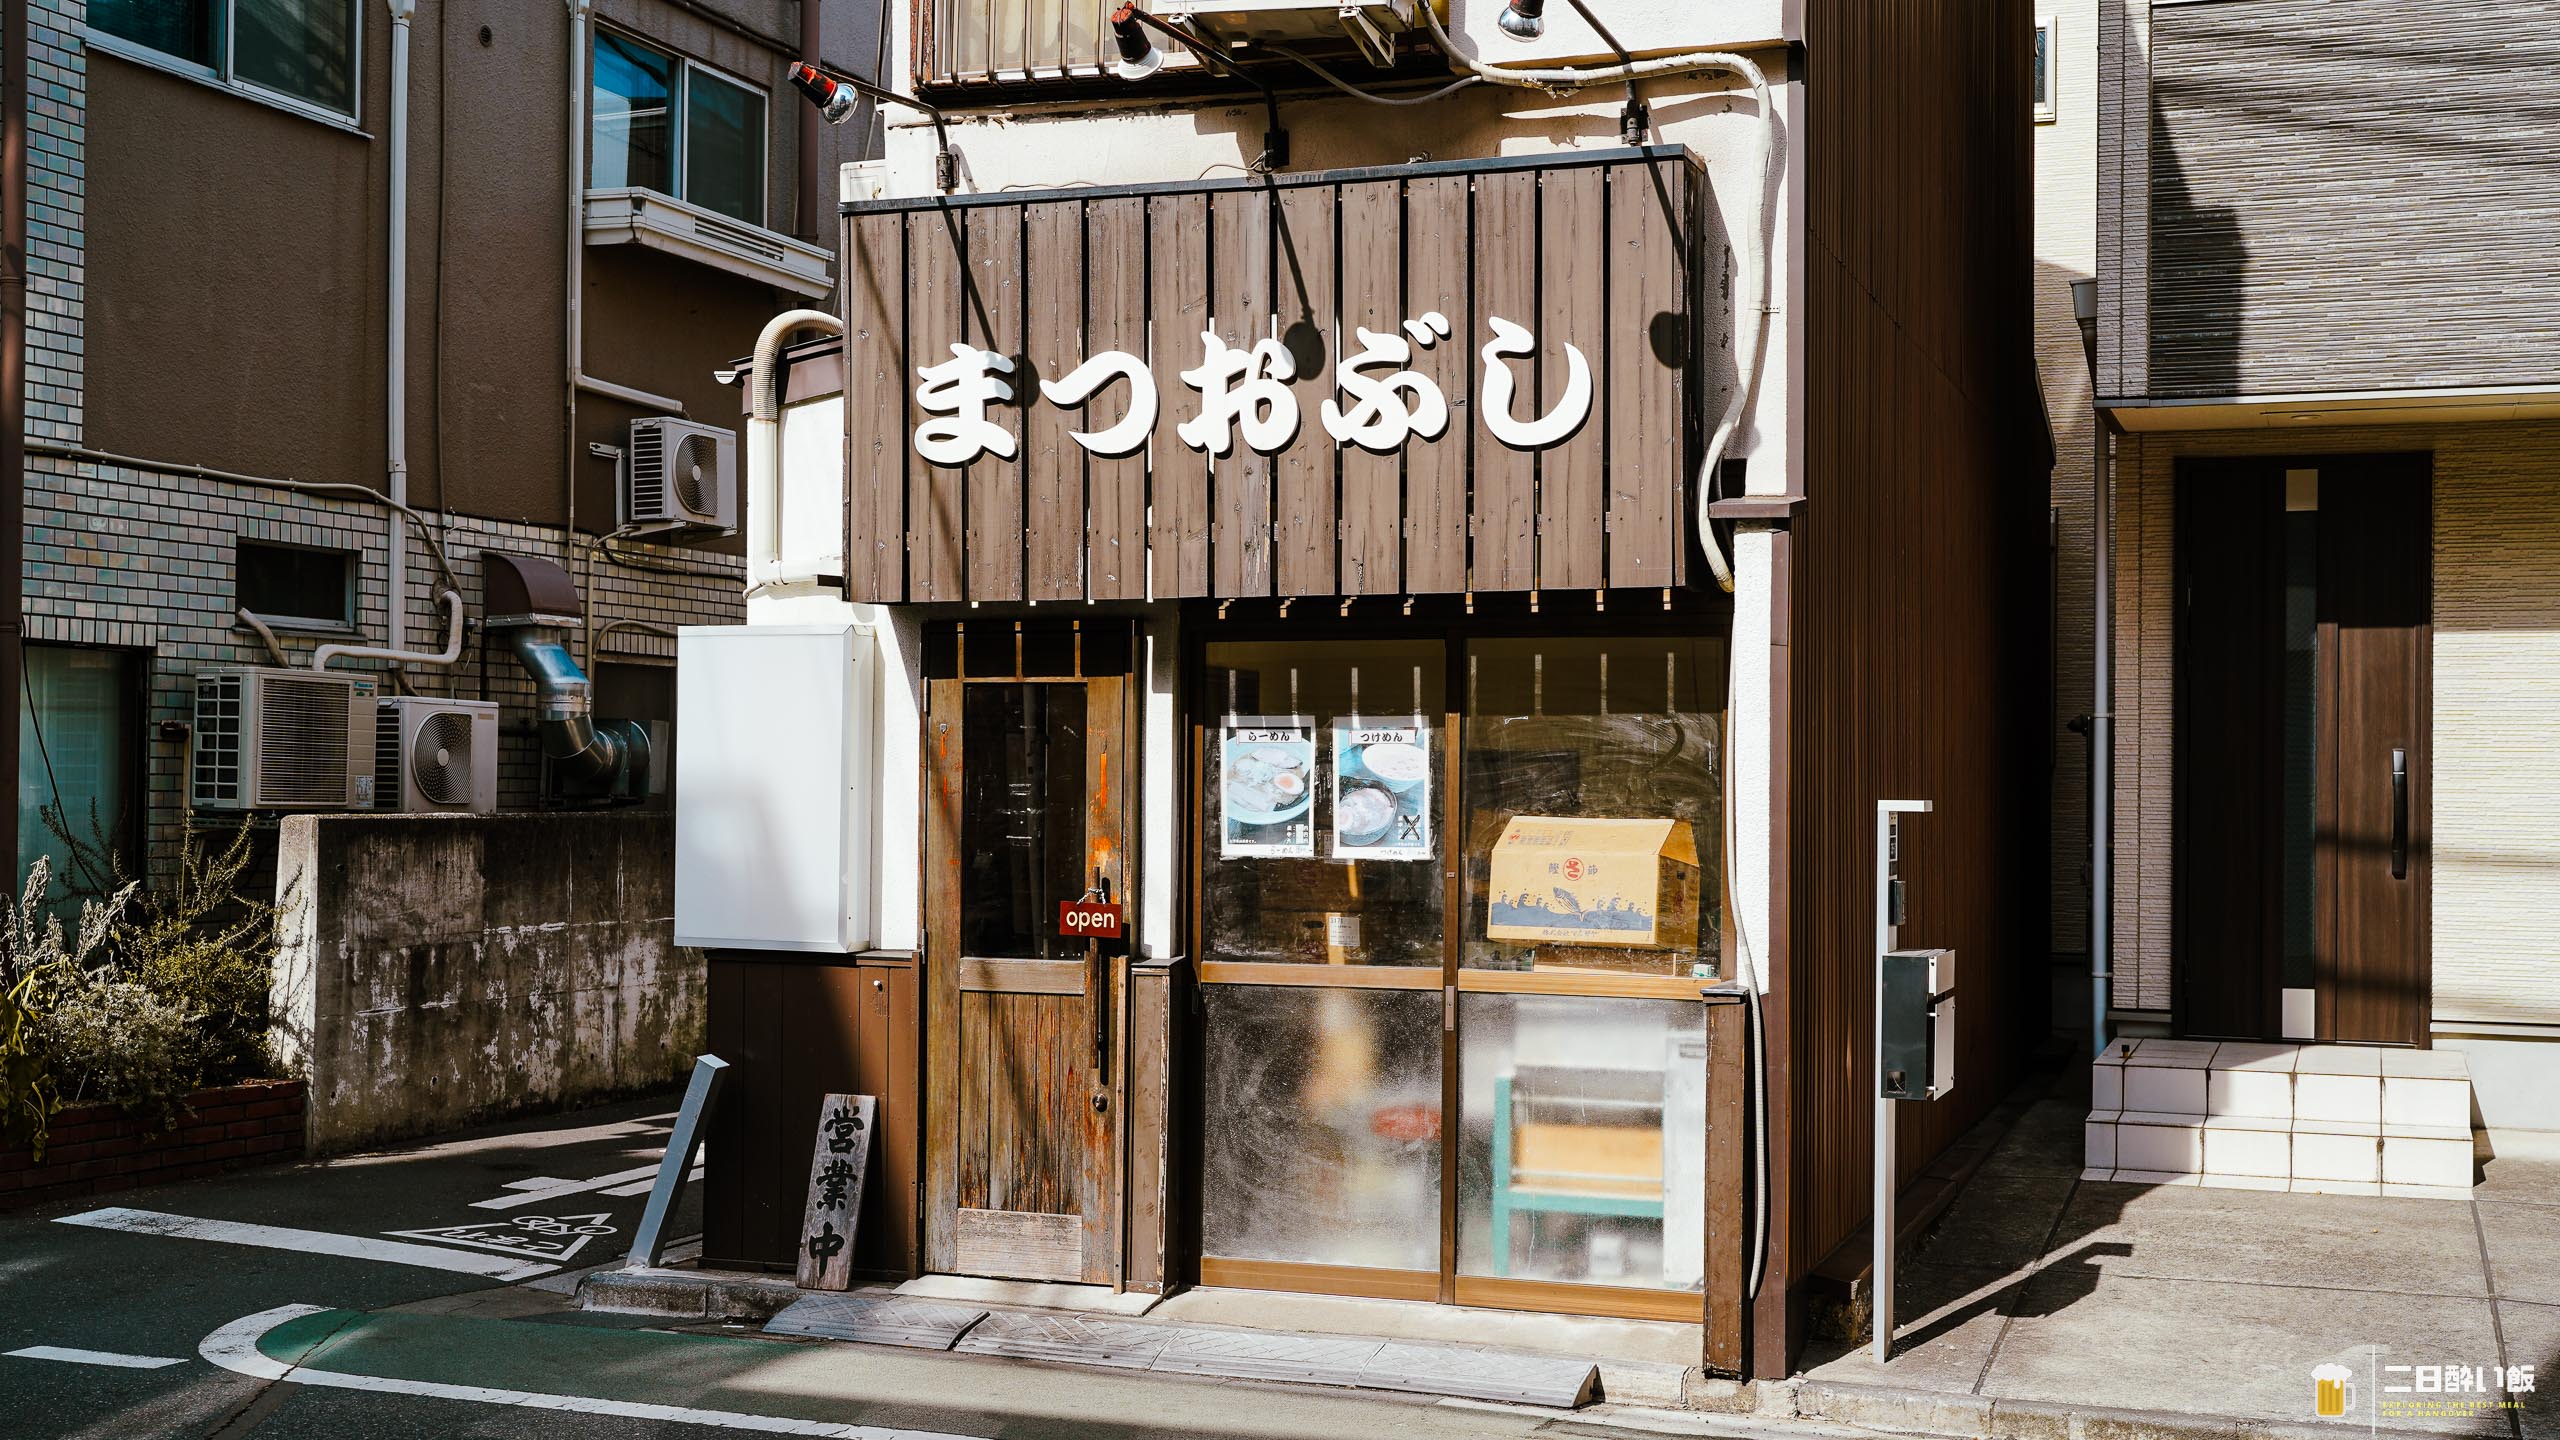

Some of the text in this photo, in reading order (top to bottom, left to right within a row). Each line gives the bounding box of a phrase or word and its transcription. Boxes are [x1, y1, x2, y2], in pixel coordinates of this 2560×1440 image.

[914, 311, 1592, 465] まつおぶし
[1247, 730, 1290, 742] らーめん
[1360, 731, 1403, 743] つけめん
[1066, 911, 1115, 932] open
[809, 1106, 864, 1279] 営業中
